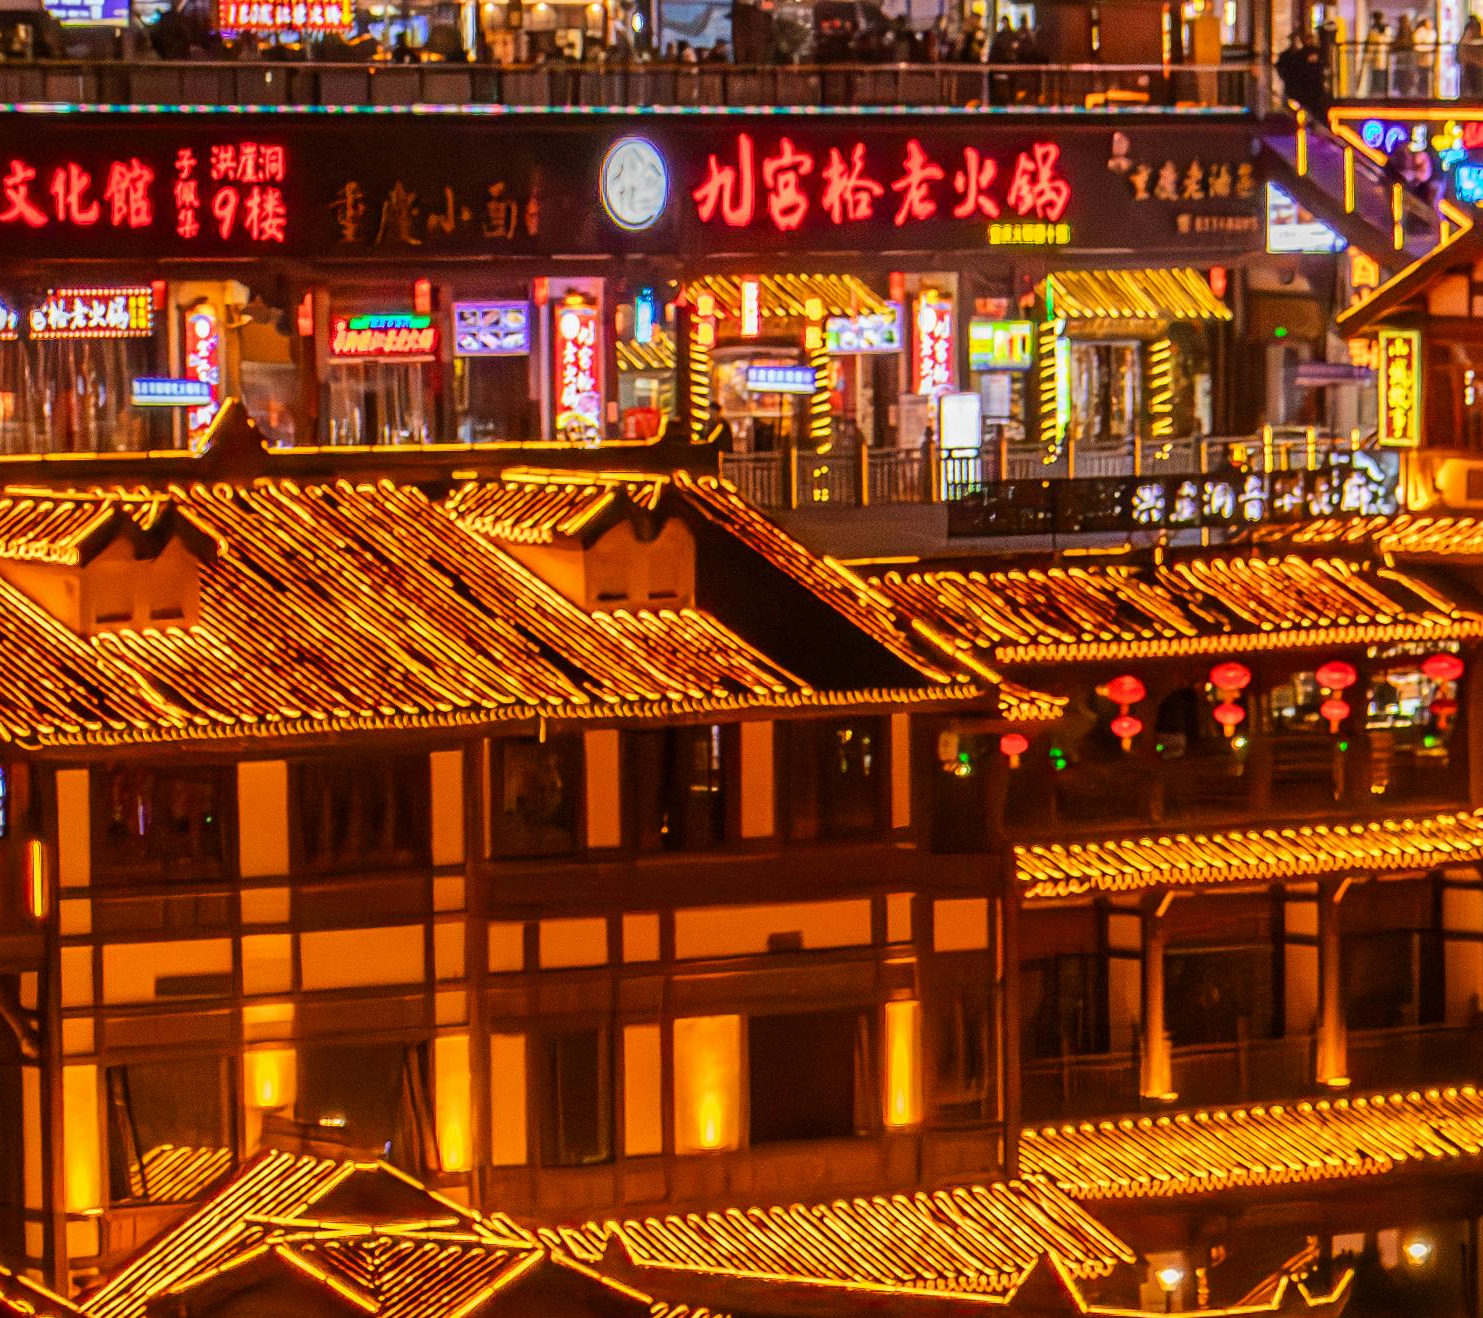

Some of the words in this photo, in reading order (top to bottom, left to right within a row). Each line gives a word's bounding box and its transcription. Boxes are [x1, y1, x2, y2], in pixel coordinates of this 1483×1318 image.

[211, 142, 285, 182] 洪崖洞
[693, 133, 1071, 230] 九宫格老火锅
[213, 186, 287, 242] 9楼
